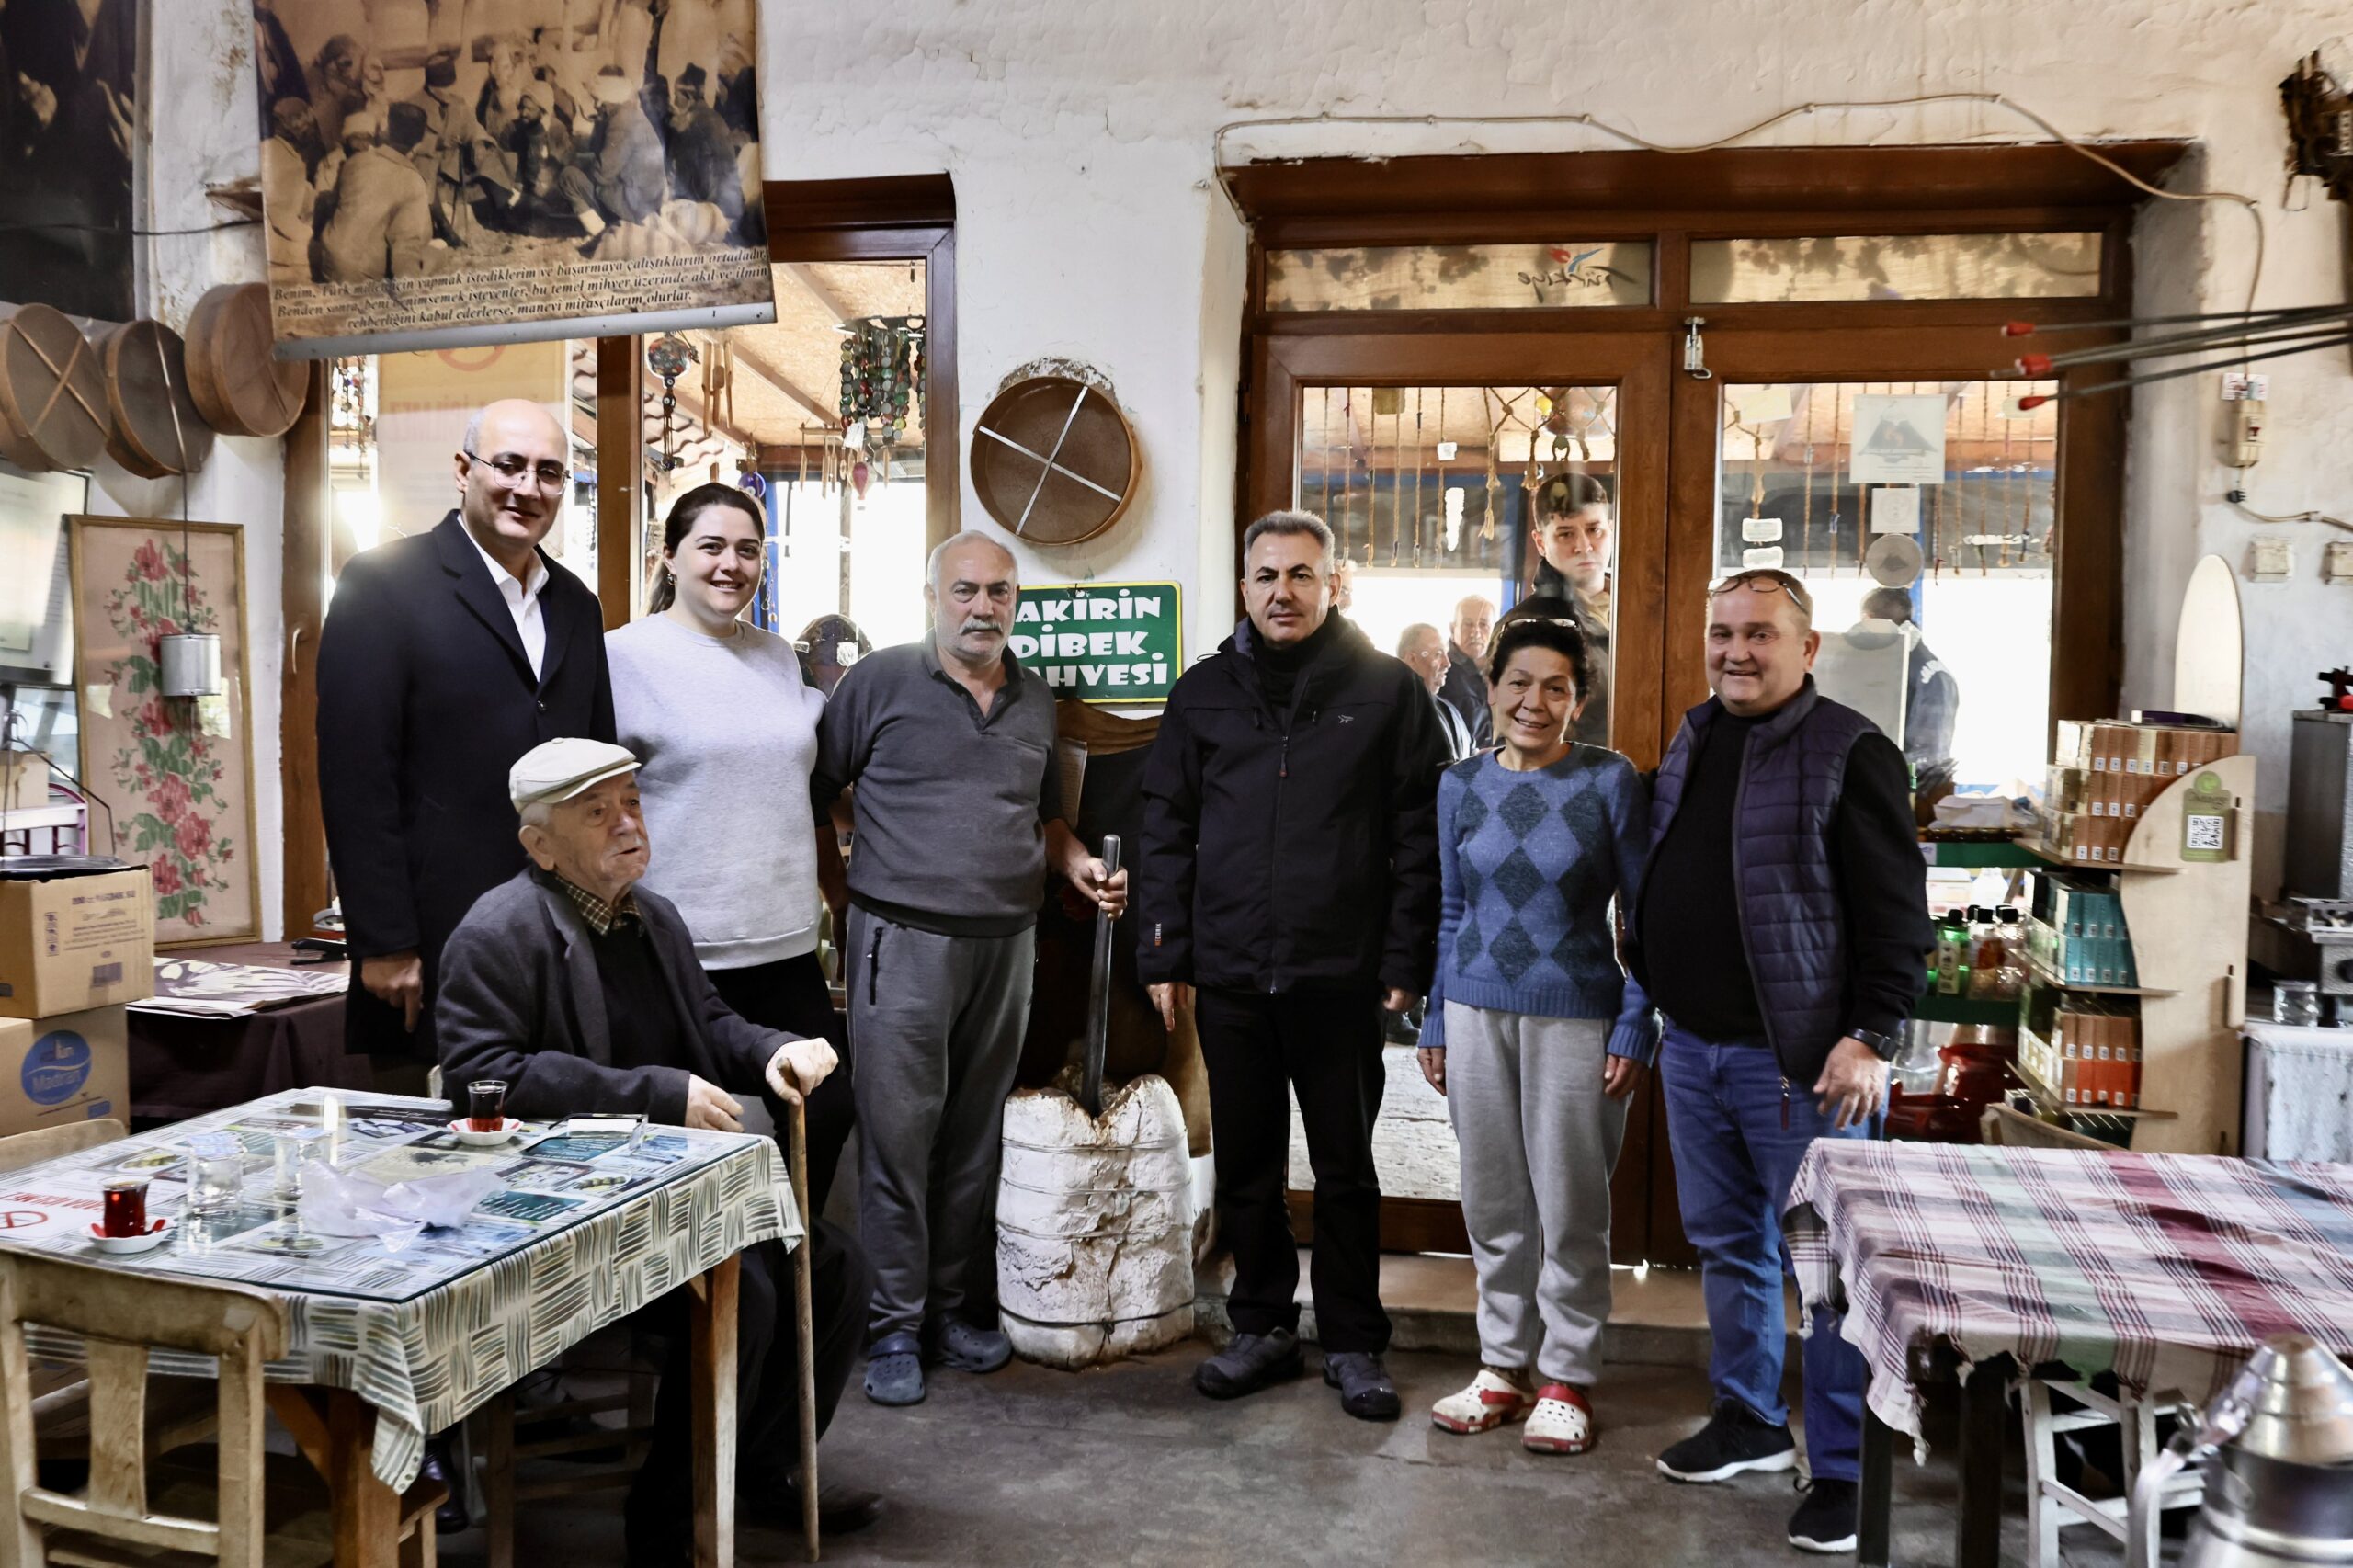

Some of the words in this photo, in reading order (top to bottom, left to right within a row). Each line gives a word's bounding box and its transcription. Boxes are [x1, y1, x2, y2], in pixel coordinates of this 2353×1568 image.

[278, 303, 323, 317] Benden
[365, 299, 389, 310] beni
[392, 291, 463, 308] benimsemek
[469, 286, 528, 302] isteyenler,
[532, 283, 547, 296] bu
[551, 279, 584, 294] temel
[587, 278, 631, 291] mihver
[634, 273, 688, 287] üzerinde
[690, 270, 715, 283] akıl
[718, 271, 733, 280] ve
[736, 266, 767, 278] ilmin
[323, 282, 350, 296] Türk
[417, 273, 463, 290] yapmak
[466, 267, 536, 284] istediklerim
[540, 269, 552, 278] ve
[557, 261, 622, 278] başarmaya
[627, 255, 704, 271] çalıştıklarım
[347, 312, 415, 327] rehberliğini
[419, 309, 452, 322] kabul
[456, 306, 513, 320] ederlerse,
[517, 300, 563, 314] manevi
[565, 293, 642, 312] mirasçılarım
[1016, 588, 1161, 622] AKİRİN
[1008, 624, 1149, 659] DİBEK
